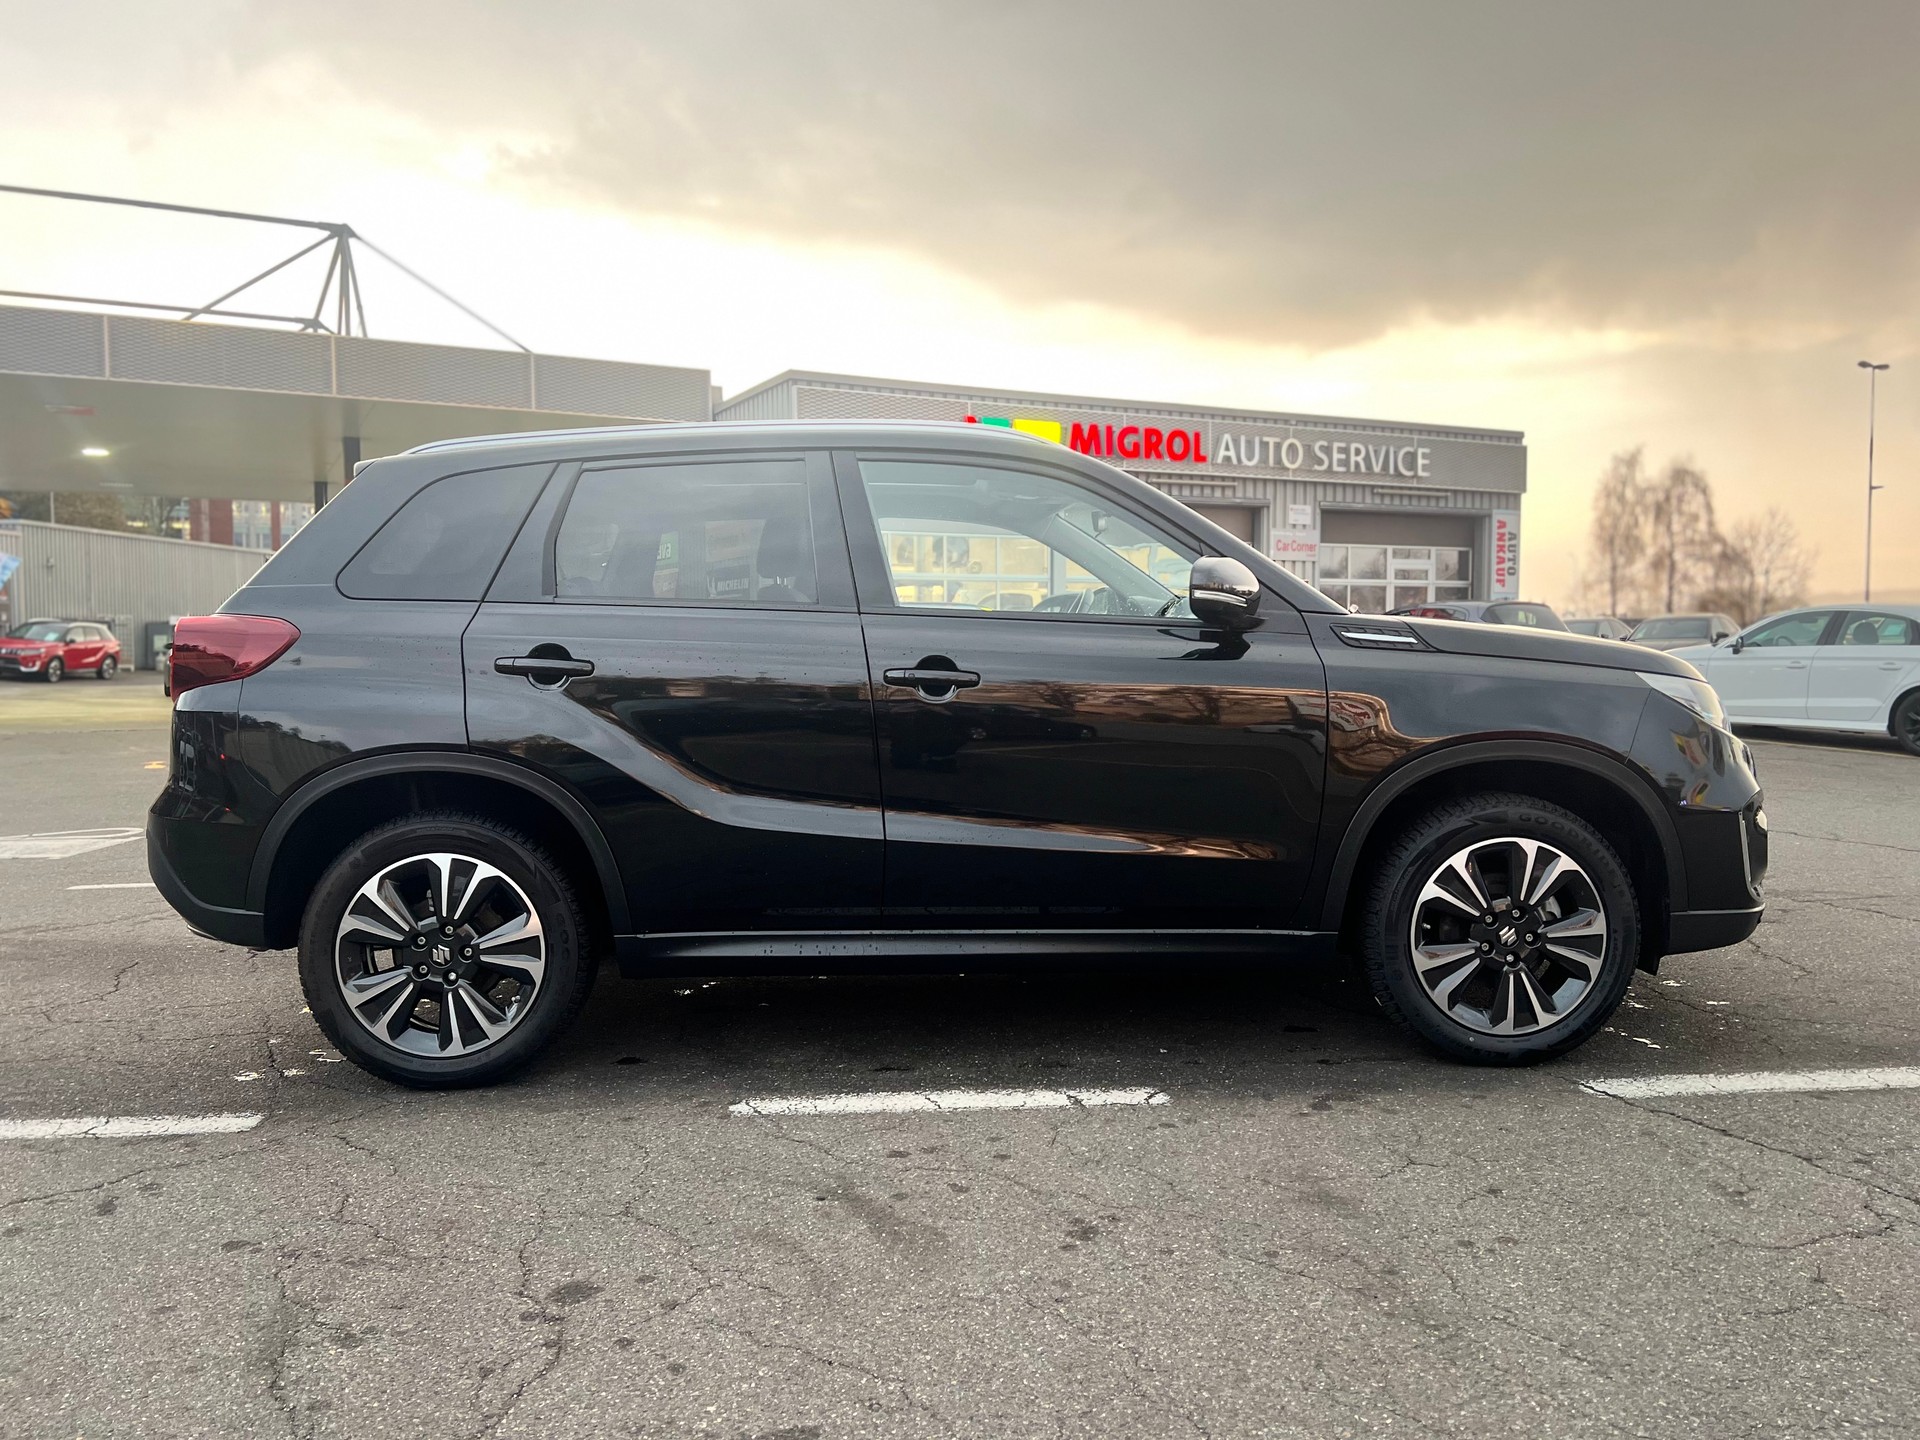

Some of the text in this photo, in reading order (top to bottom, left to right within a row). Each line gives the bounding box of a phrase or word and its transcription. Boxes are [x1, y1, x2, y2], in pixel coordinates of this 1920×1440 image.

[1069, 422, 1431, 477] MIGROL AUTO SERVICE
[1496, 519, 1507, 588] ANKAUF
[1507, 531, 1517, 577] AUTO
[716, 577, 749, 592] MICHELIN
